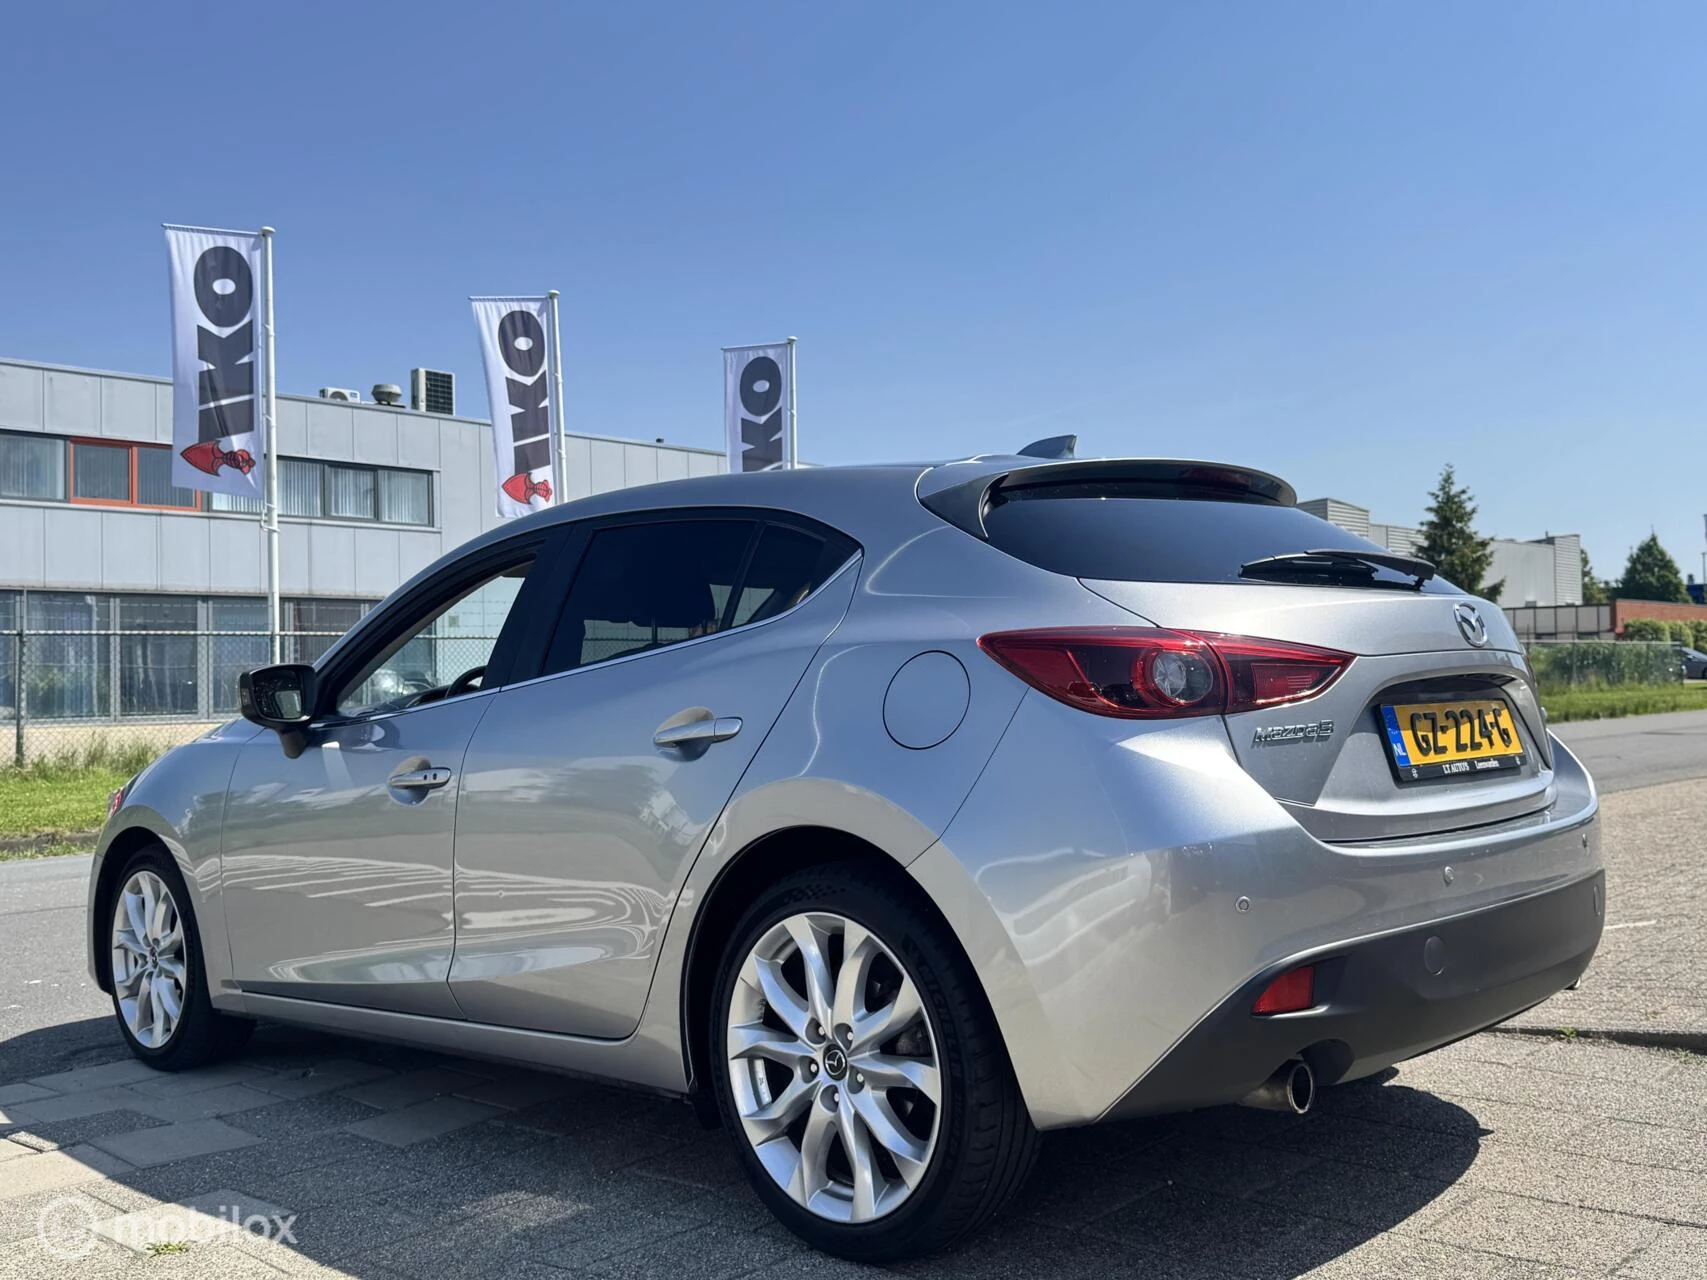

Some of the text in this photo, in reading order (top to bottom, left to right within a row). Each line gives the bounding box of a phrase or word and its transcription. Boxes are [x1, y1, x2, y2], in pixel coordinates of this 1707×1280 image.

[194, 246, 255, 443] IKO
[498, 310, 552, 475] IKO
[739, 356, 784, 472] KO
[1393, 742, 1407, 757] NL
[1410, 705, 1512, 757] GZ-224-G
